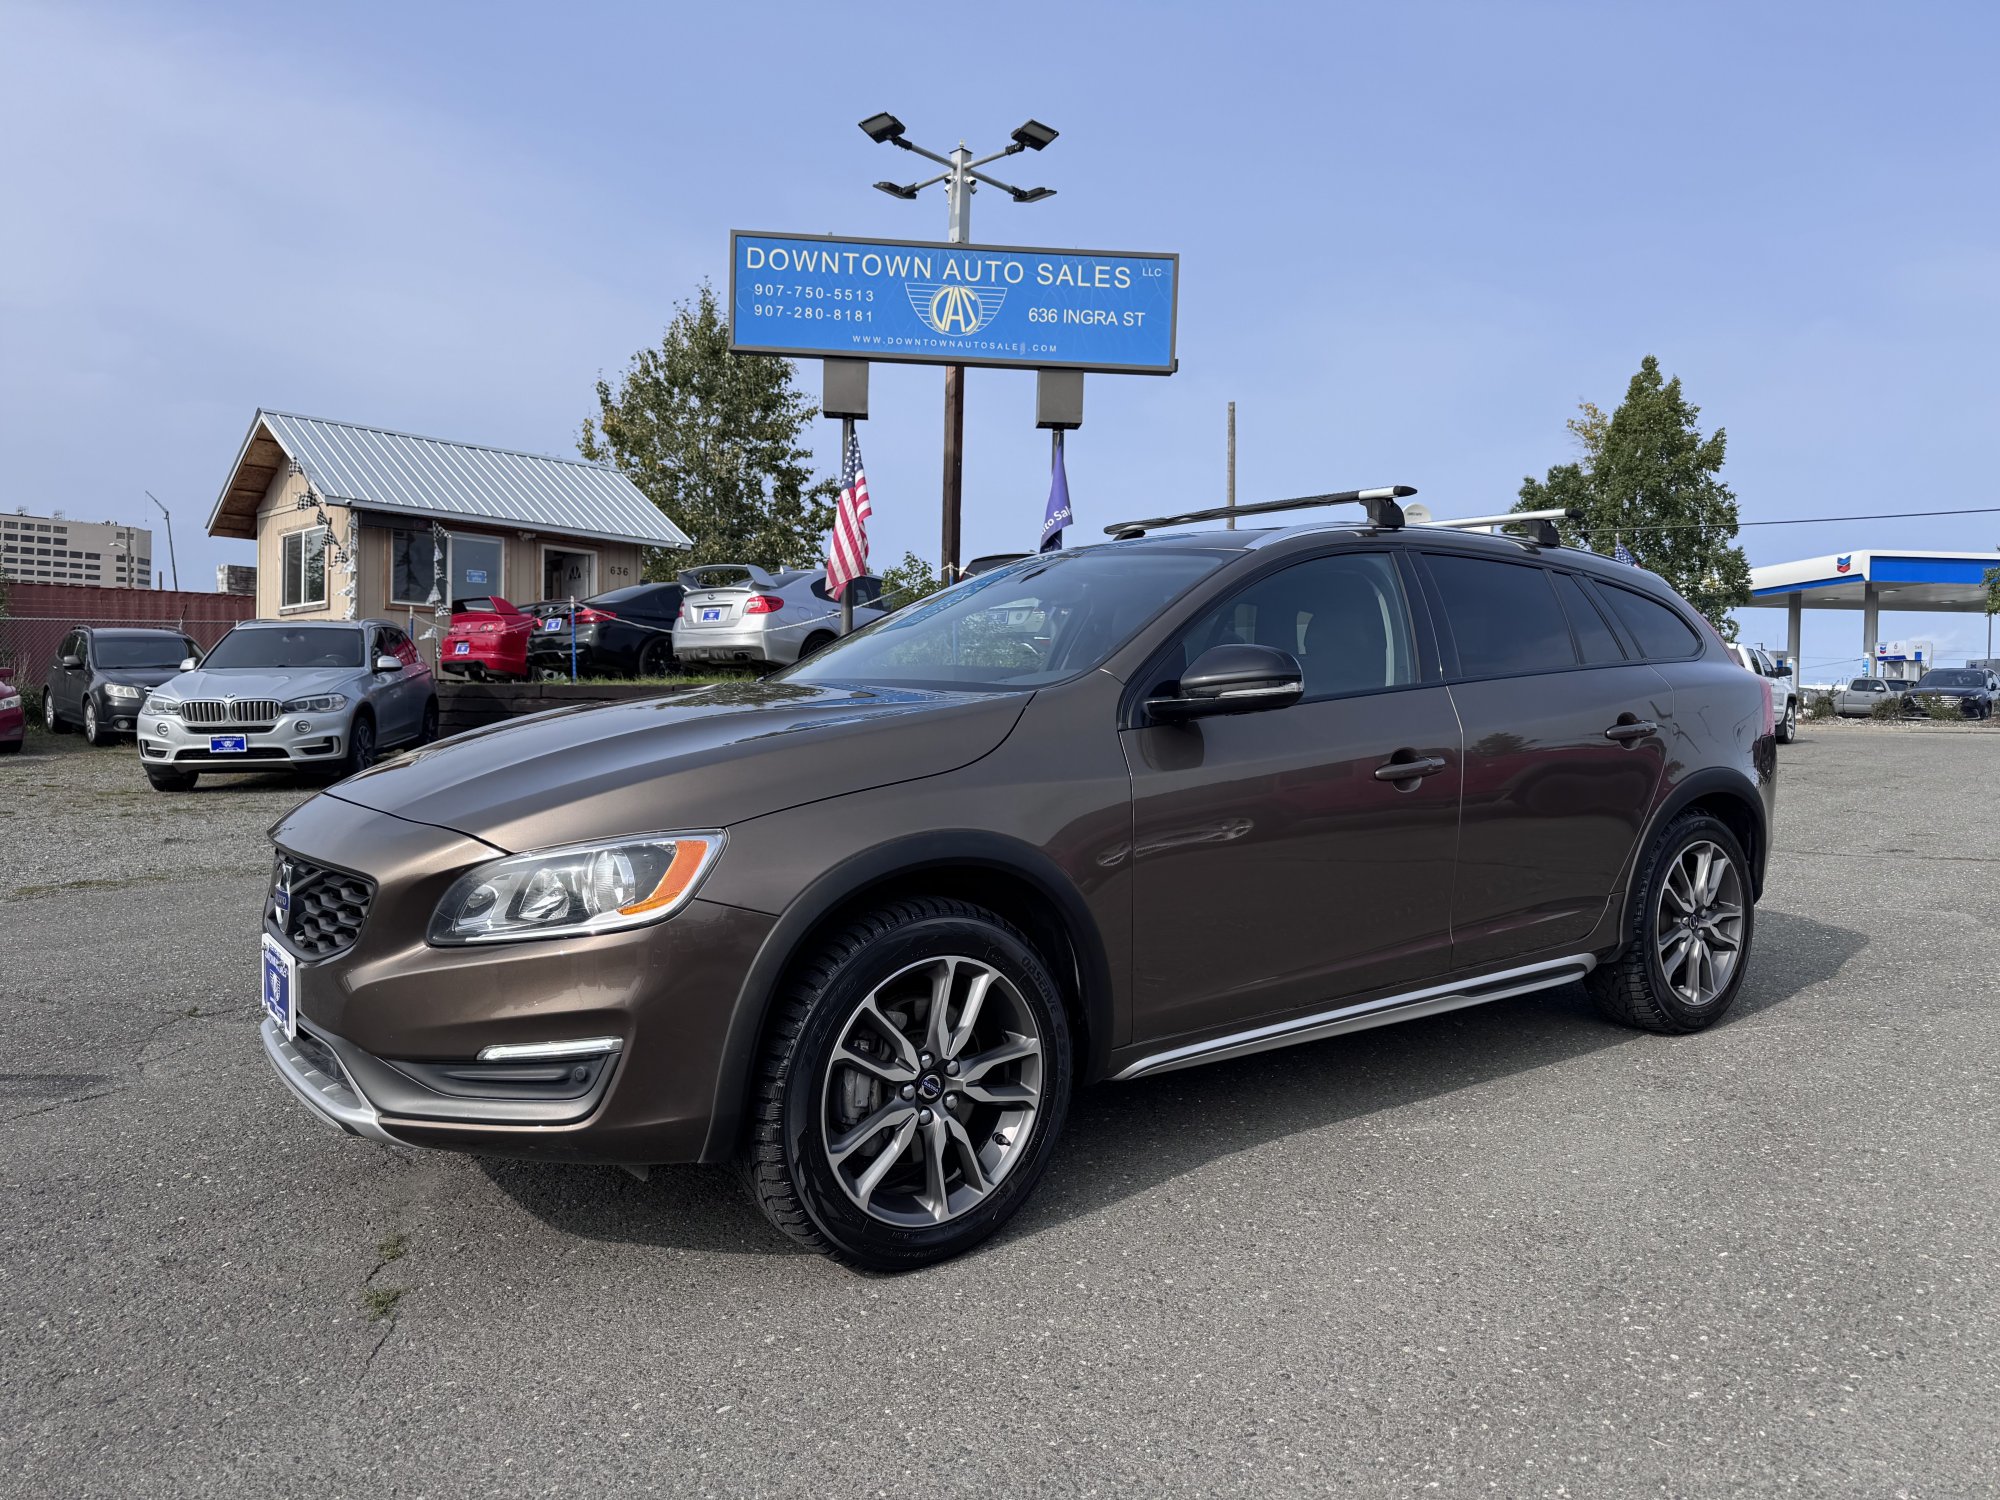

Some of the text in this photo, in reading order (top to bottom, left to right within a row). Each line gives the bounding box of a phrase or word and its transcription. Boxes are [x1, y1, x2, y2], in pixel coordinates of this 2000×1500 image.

[747, 247, 1162, 289] DOWNTOWN AUTO SALES LLC
[754, 283, 874, 302] 907-750-5513
[754, 304, 873, 322] 907-280-8181
[1028, 307, 1146, 327] 636 INGRA ST
[610, 566, 629, 576] 636
